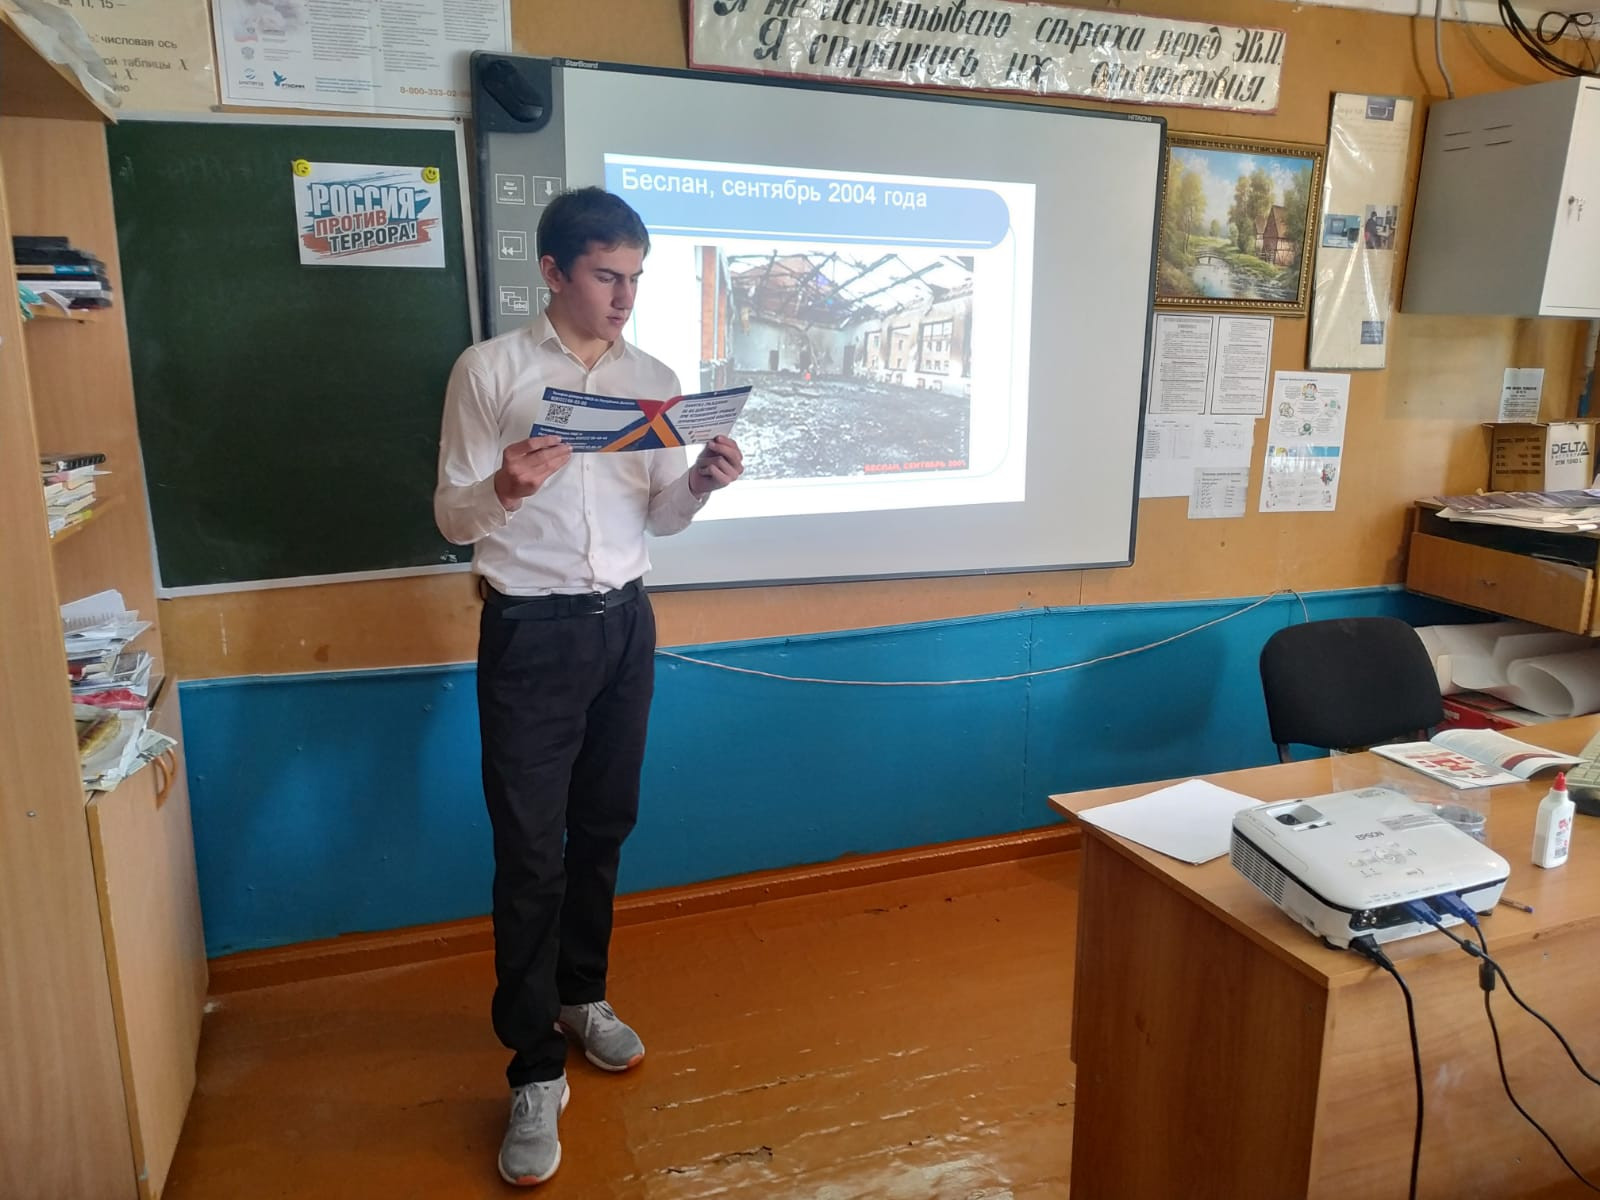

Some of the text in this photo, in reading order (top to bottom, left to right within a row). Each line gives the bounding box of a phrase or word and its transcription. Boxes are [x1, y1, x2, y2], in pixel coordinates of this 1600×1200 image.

[101, 36, 155, 47] числовая
[157, 40, 178, 48] ось
[753, 17, 788, 61] Я
[1035, 16, 1146, 54] страха
[1154, 26, 1223, 63] перед
[123, 58, 171, 69] таблицы
[1127, 114, 1152, 122] HITACHI
[311, 183, 416, 220] РОССИЯ
[622, 168, 928, 210] Беслан, сентябрь 2004 года
[315, 210, 388, 236] ПРОТИВ
[329, 222, 417, 252] ТЕРРОРА!
[1551, 441, 1589, 455] DELTA
